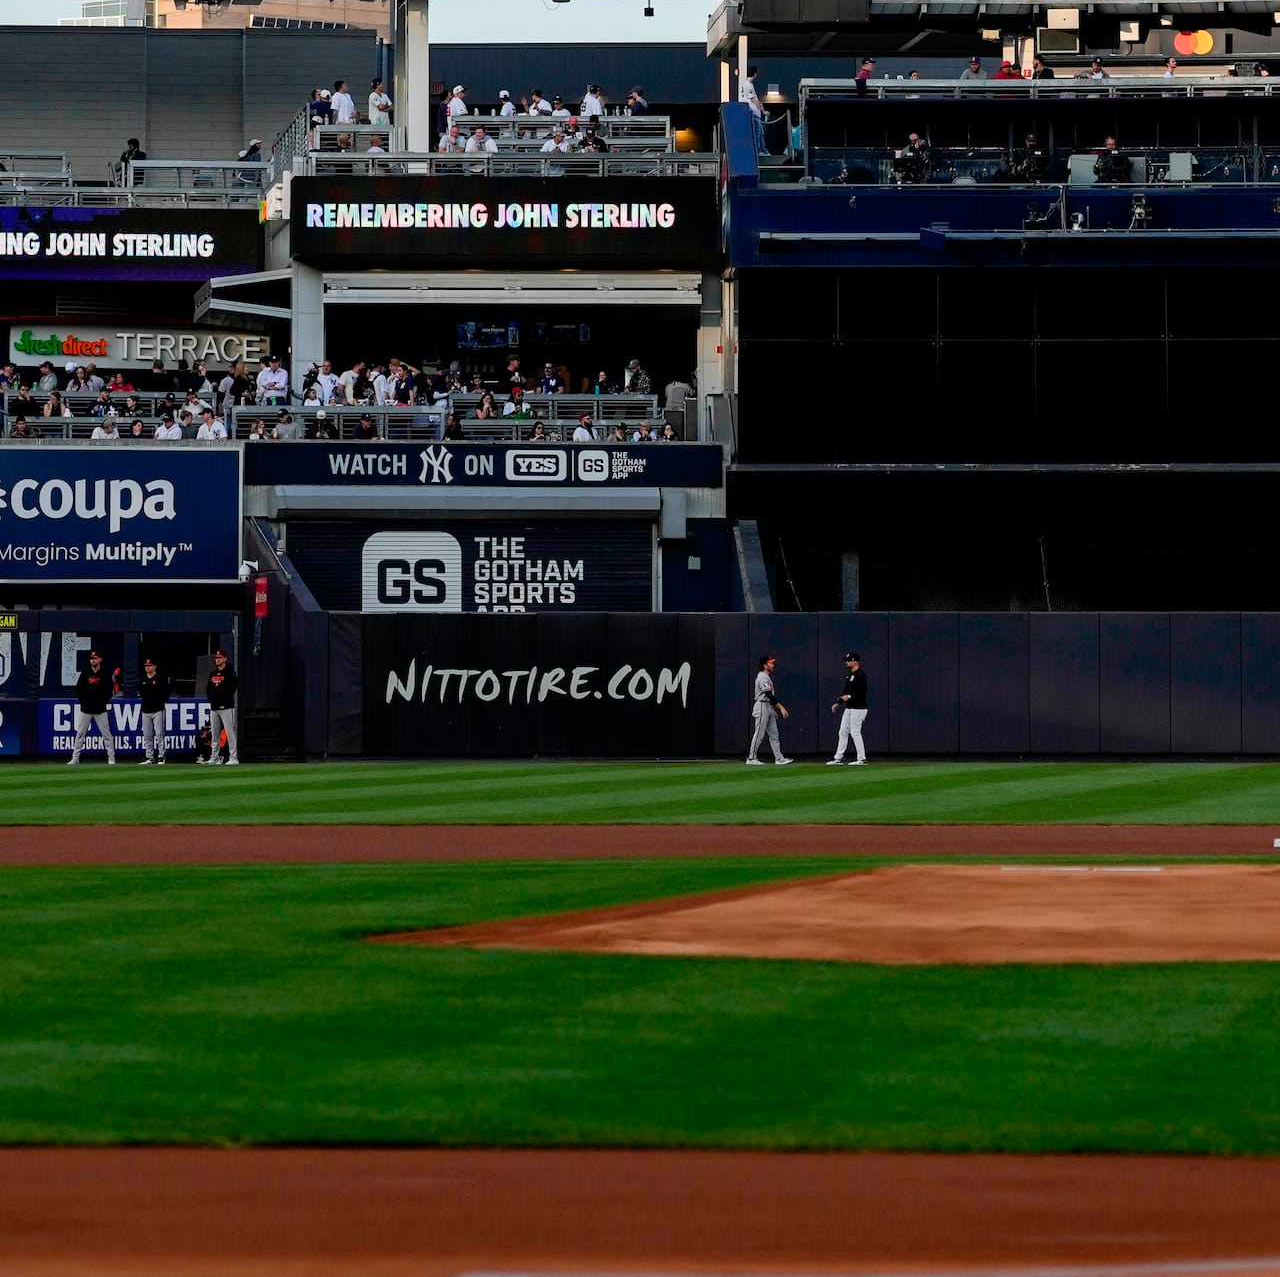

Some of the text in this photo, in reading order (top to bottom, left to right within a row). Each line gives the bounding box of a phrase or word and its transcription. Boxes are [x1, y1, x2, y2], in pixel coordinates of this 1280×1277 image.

[306, 202, 675, 230] REMEMBERING JOHN STERLING
[45, 231, 108, 257] JOHN
[112, 232, 215, 258] STERLING
[116, 332, 262, 363] TERRACE
[328, 453, 407, 476] WATCH
[464, 454, 494, 476] ON
[515, 457, 558, 474] YES
[583, 458, 604, 473] GS
[10, 477, 177, 534] coupa
[473, 536, 526, 559] THE
[377, 558, 447, 604] GS
[474, 559, 585, 582] GOTHAM
[474, 582, 577, 604] SPORTS
[385, 658, 692, 709] NITTOTIRE.COM
